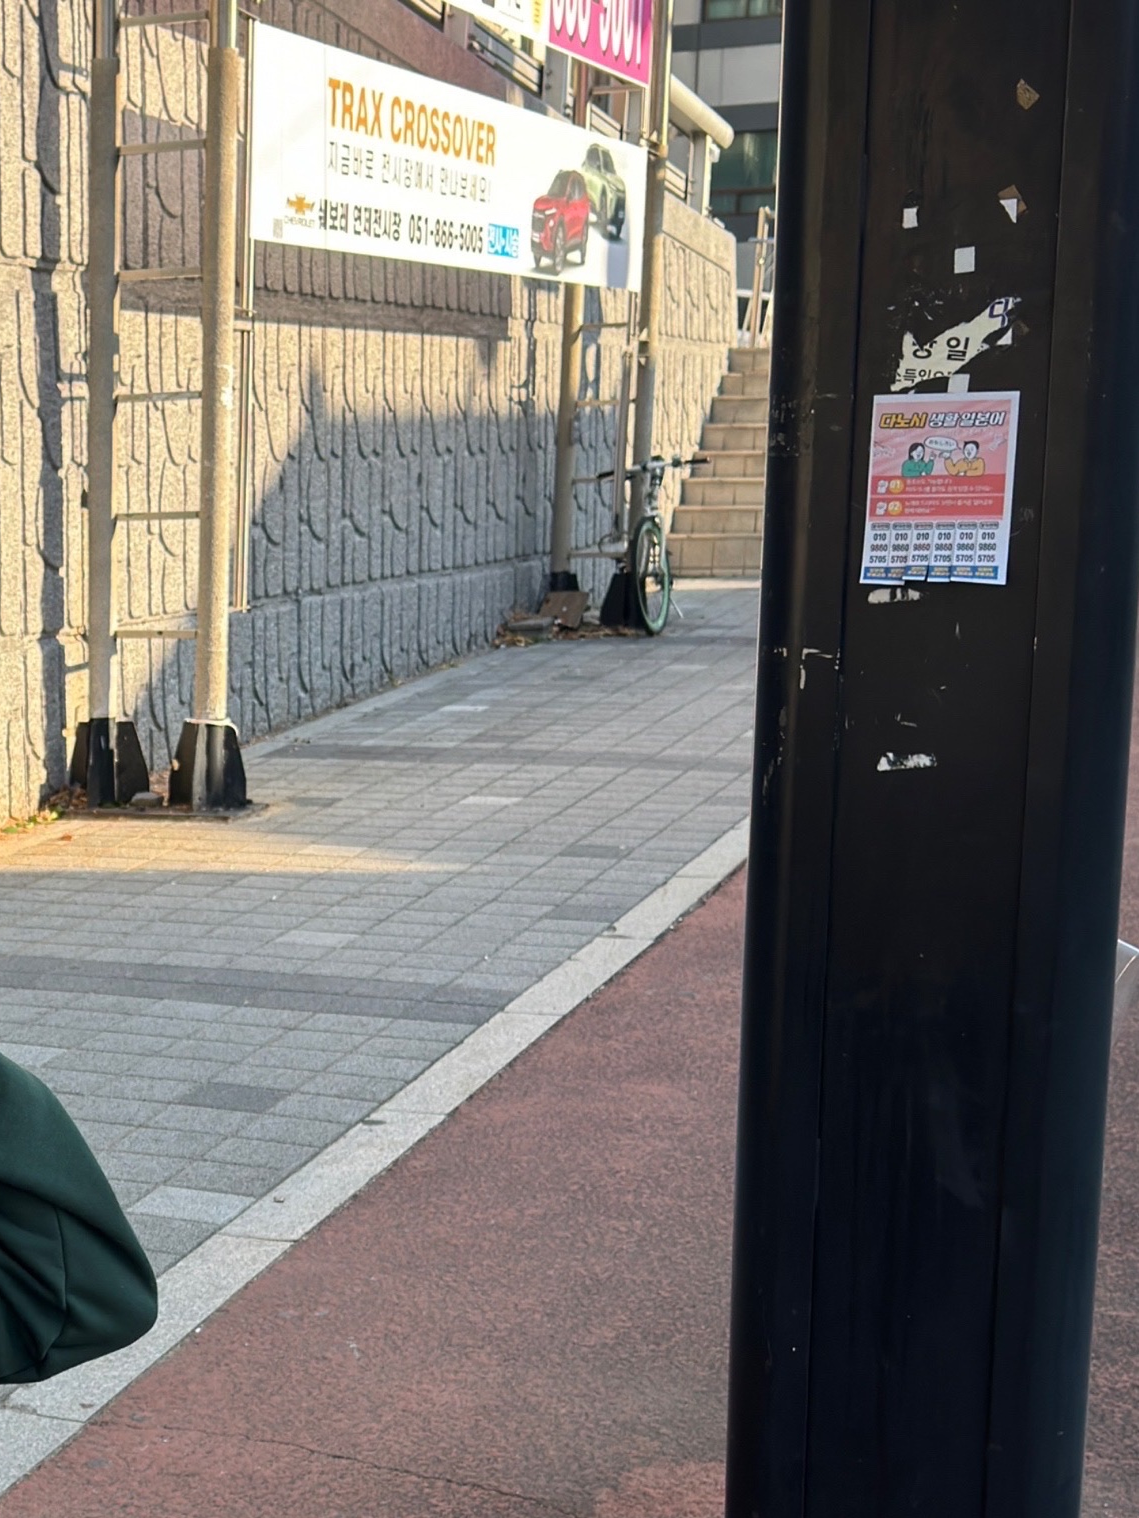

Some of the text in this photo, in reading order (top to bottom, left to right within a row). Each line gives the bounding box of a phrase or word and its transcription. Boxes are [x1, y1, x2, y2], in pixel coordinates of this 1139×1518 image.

[328, 77, 495, 166] TRAX CROSSOVER
[328, 141, 374, 180] 지금바로
[319, 199, 349, 233] 쉐보레
[408, 213, 483, 254] 051-866-5005
[873, 533, 887, 541] 010
[895, 533, 908, 541] 010
[916, 532, 930, 541] 010
[938, 532, 951, 540] 010
[959, 532, 974, 540] 010
[981, 532, 995, 540] 010
